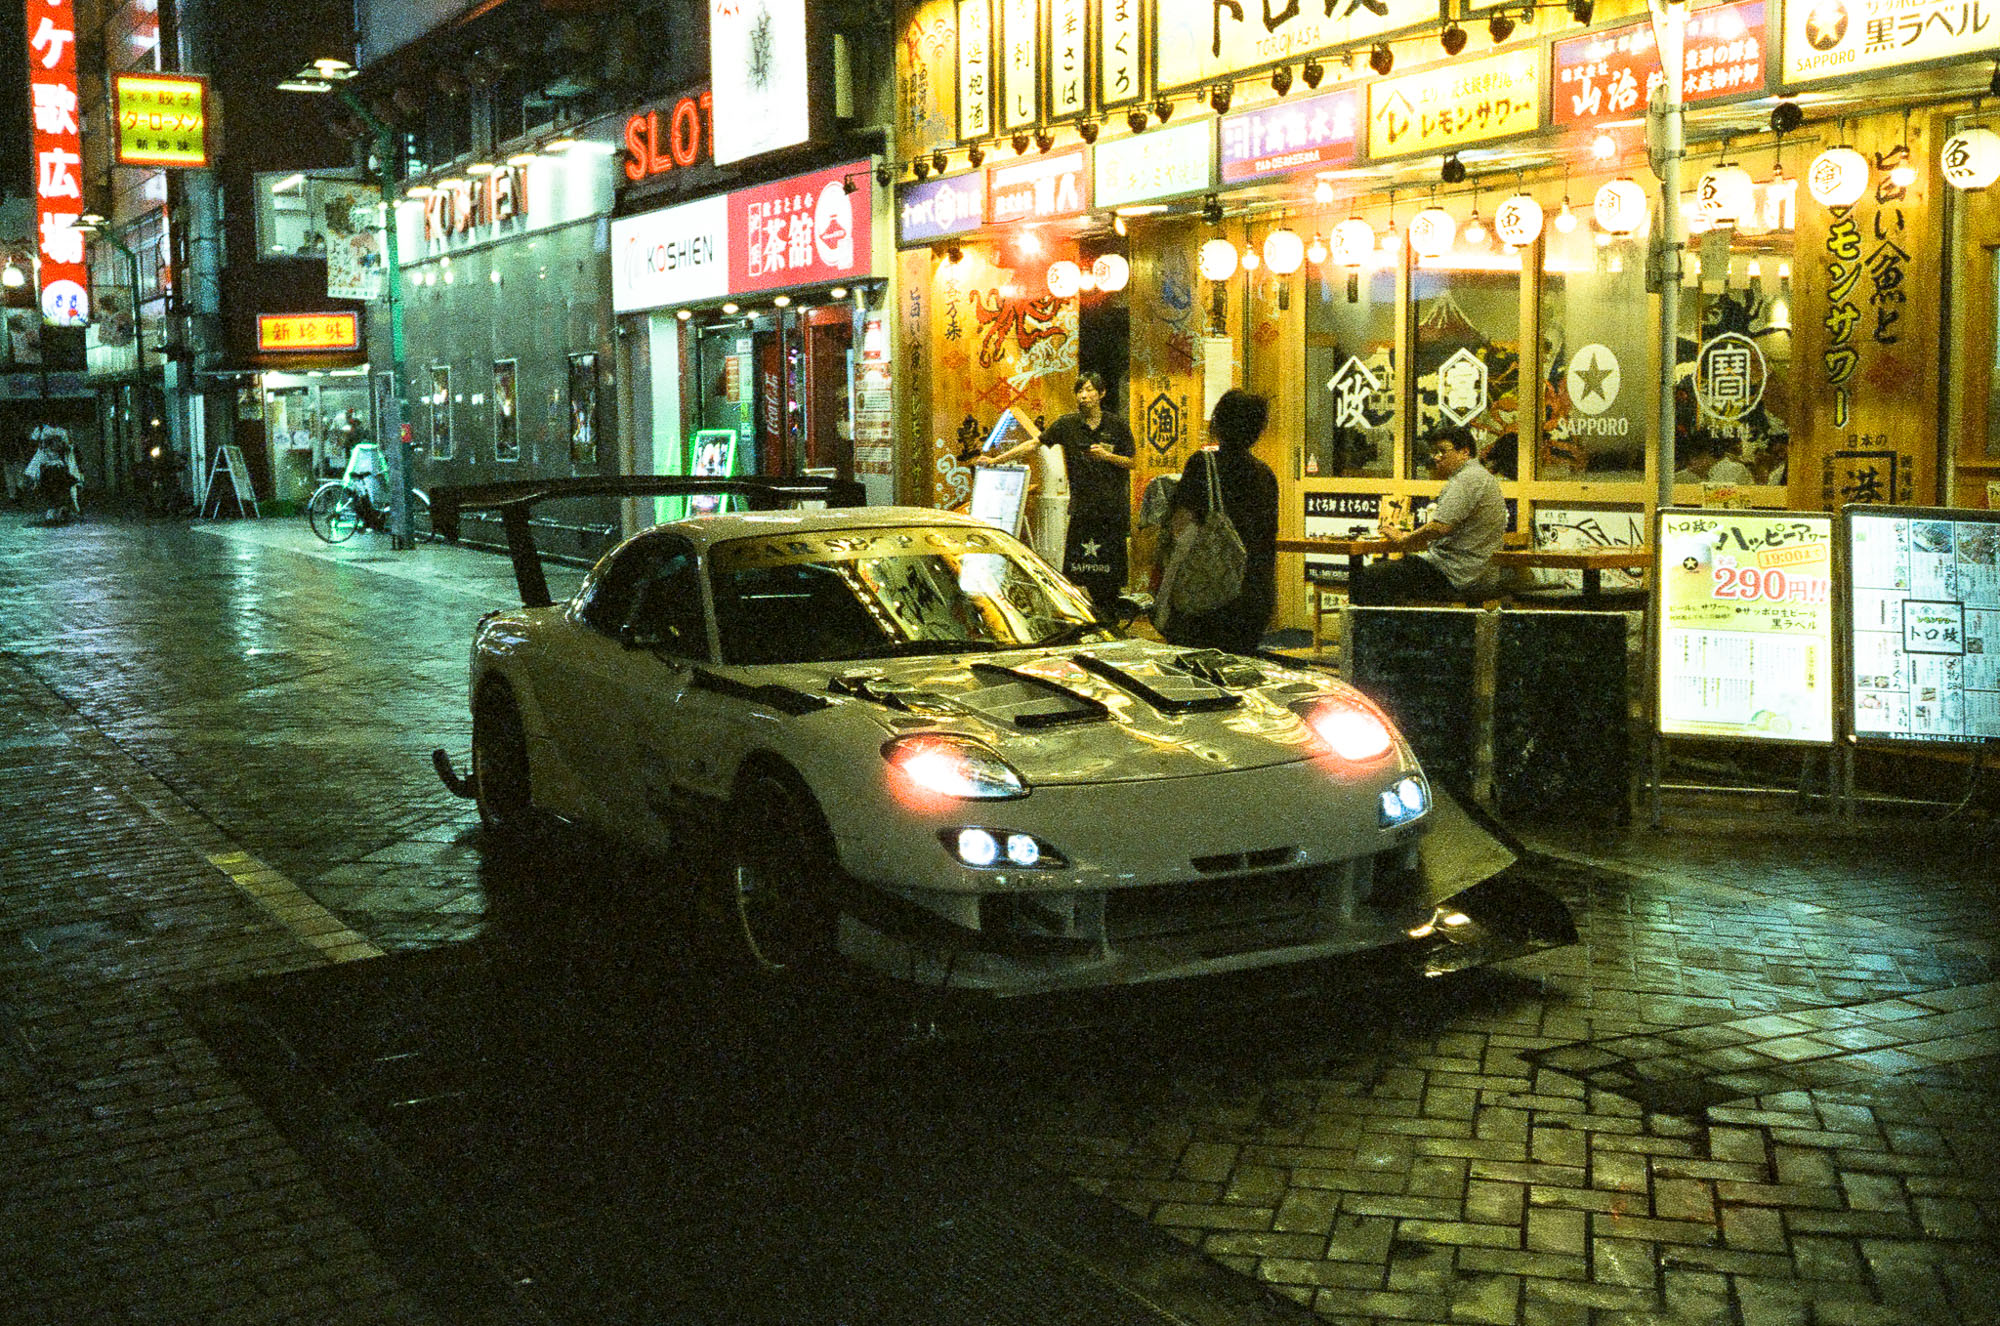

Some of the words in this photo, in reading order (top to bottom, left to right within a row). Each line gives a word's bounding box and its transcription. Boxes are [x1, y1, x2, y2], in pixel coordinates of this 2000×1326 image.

[1864, 1, 1990, 54] 黒ラベル
[1796, 48, 1856, 72] SAPPORO
[122, 111, 200, 132] ターローメン
[1421, 98, 1530, 139] レモンサワー
[32, 0, 83, 264] ケ歌広場
[1945, 138, 1976, 178] 魚
[1501, 205, 1523, 236] 魚
[647, 234, 713, 273] KOSHIEN
[1824, 206, 1863, 429] モンサワー
[273, 322, 344, 342] 新珍味
[1557, 417, 1629, 437] SAPPORO
[1847, 434, 1888, 448] 日本の
[1340, 499, 1381, 513] まぐろのこ
[1668, 520, 1718, 534] トロ政の
[1715, 522, 1829, 552] ハッピーアワー
[1070, 562, 1111, 573] SAPPORO
[1714, 567, 1827, 602] 290円!!
[1771, 618, 1817, 630] 黒ラベル
[1911, 625, 1961, 644] トロ政
